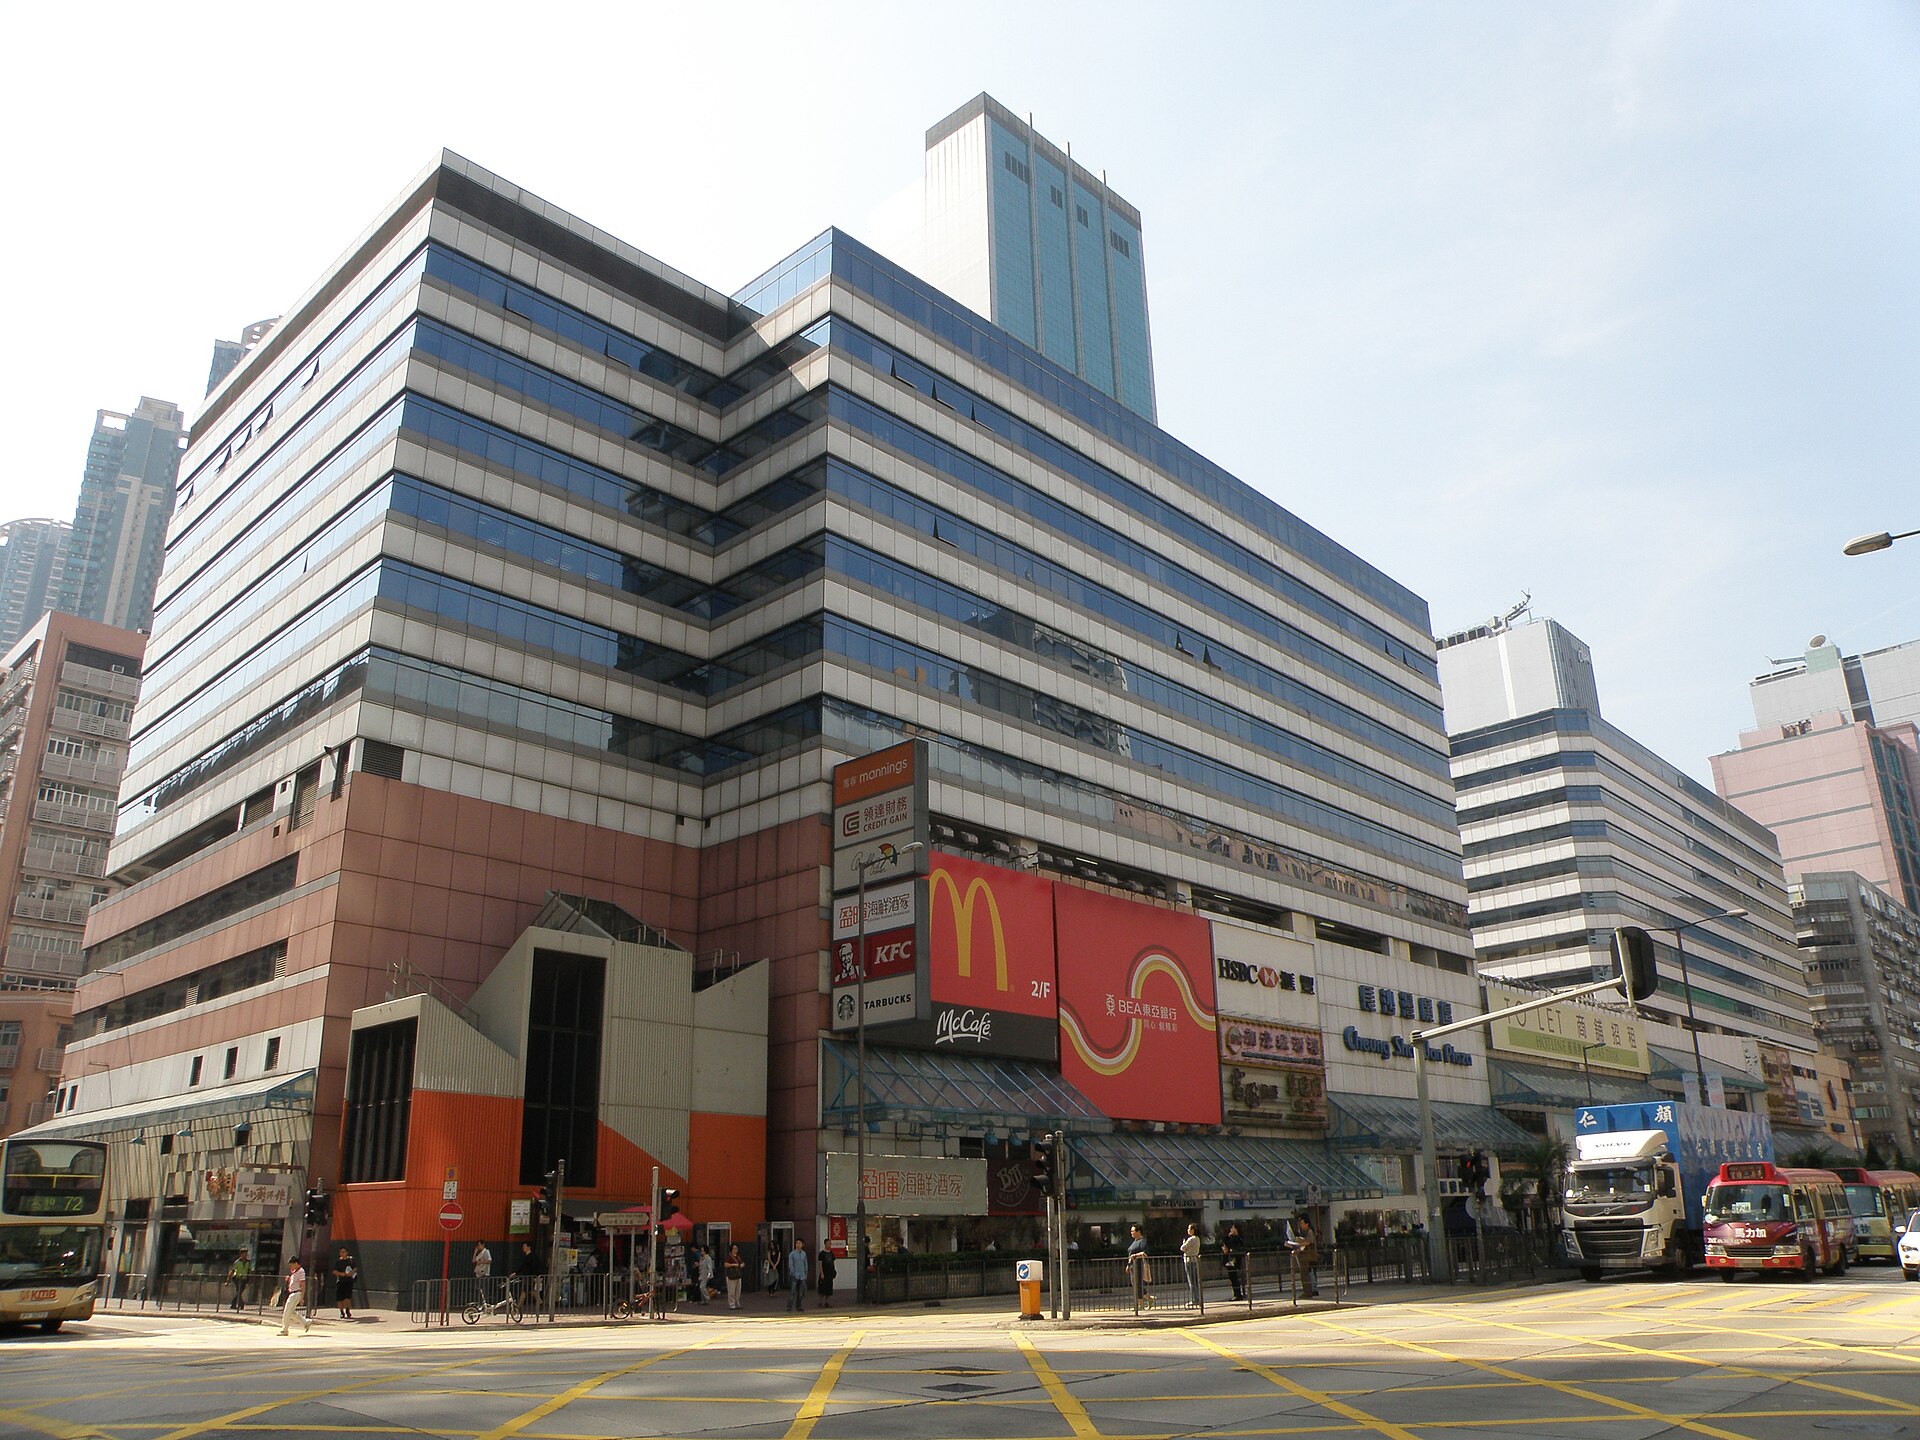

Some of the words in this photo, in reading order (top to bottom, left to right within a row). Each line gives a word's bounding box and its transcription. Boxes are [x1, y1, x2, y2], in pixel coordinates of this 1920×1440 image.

[860, 759, 908, 783] mannings
[864, 797, 907, 821] 領達財務
[863, 819, 887, 832] CREDIT
[889, 812, 907, 824] GAIN
[874, 940, 912, 965] KFC
[1217, 957, 1259, 985] HSBC
[1031, 980, 1050, 999] 2/F
[864, 993, 912, 1010] TARBUCKS
[1118, 999, 1142, 1016] BEA
[1142, 1003, 1177, 1021] 東亞銀行
[1504, 997, 1527, 1028] TO
[1536, 1007, 1562, 1035] LET
[1343, 1025, 1391, 1060] Cheung
[1442, 1043, 1473, 1066] Plaza
[1578, 1110, 1598, 1128] 仁
[64, 1195, 82, 1211] 72
[1734, 1228, 1767, 1239] 馬力加
[30, 1289, 57, 1301] KMB
